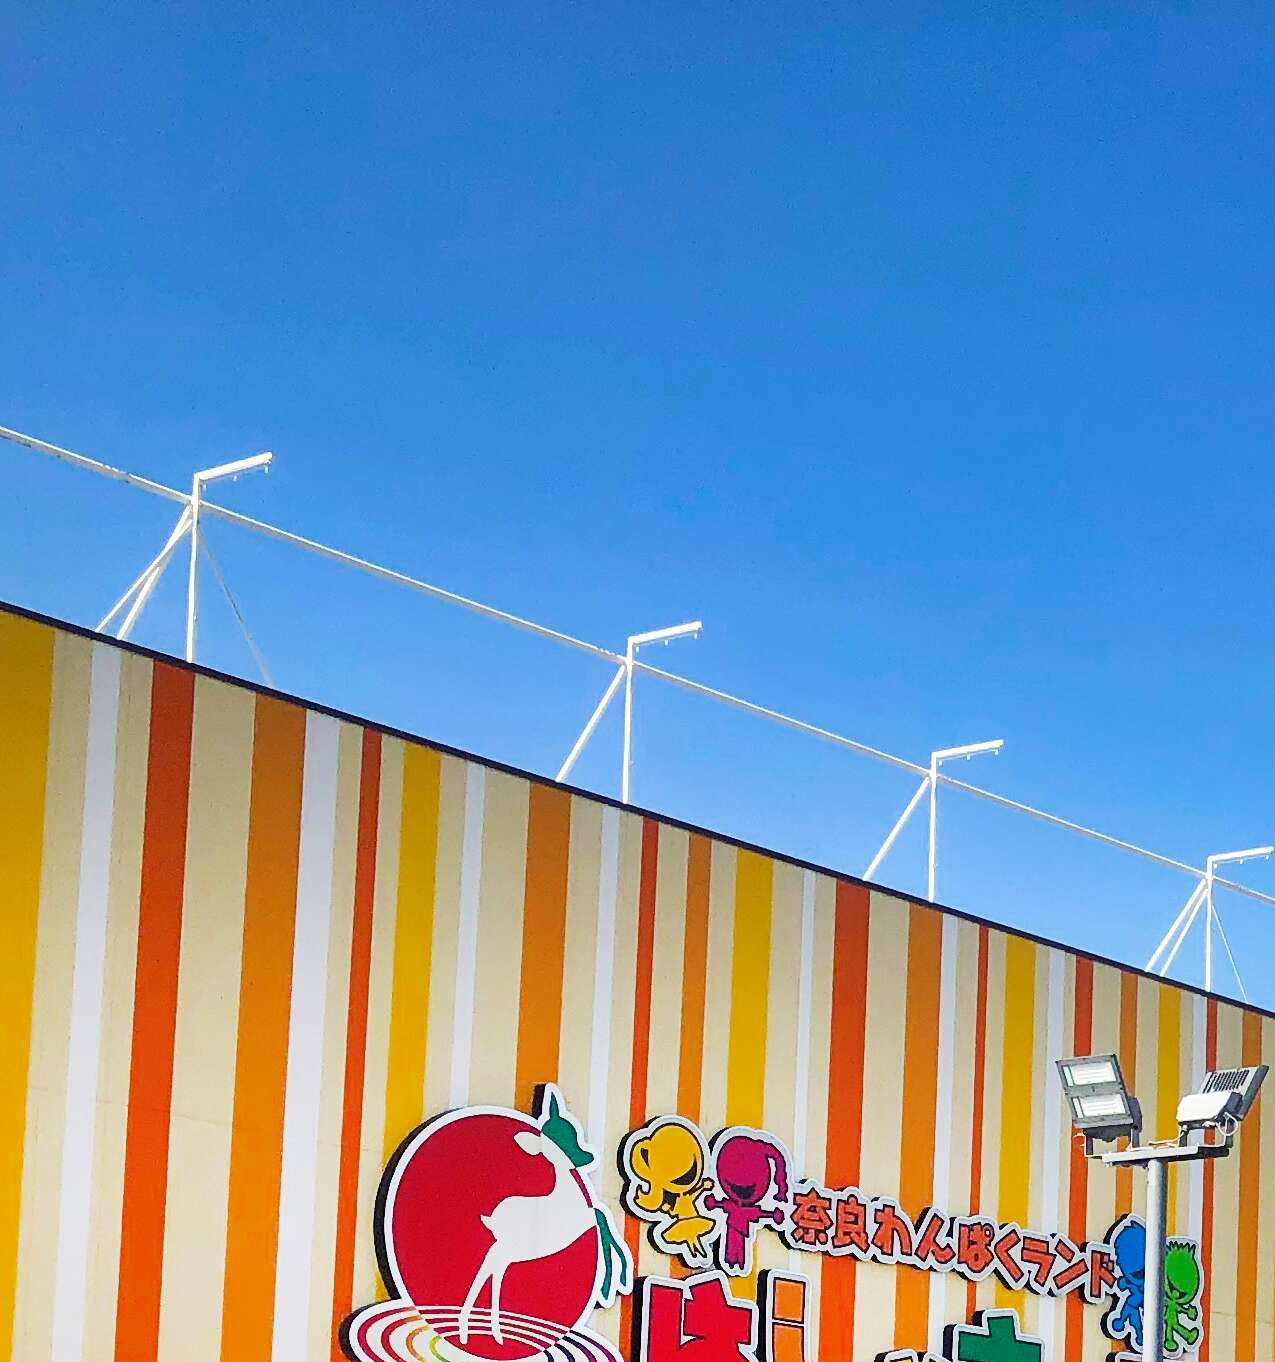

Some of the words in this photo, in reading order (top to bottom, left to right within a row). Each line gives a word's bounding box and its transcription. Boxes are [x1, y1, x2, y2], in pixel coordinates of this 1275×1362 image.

[789, 1186, 1118, 1299] 奈良わんぱくランド
